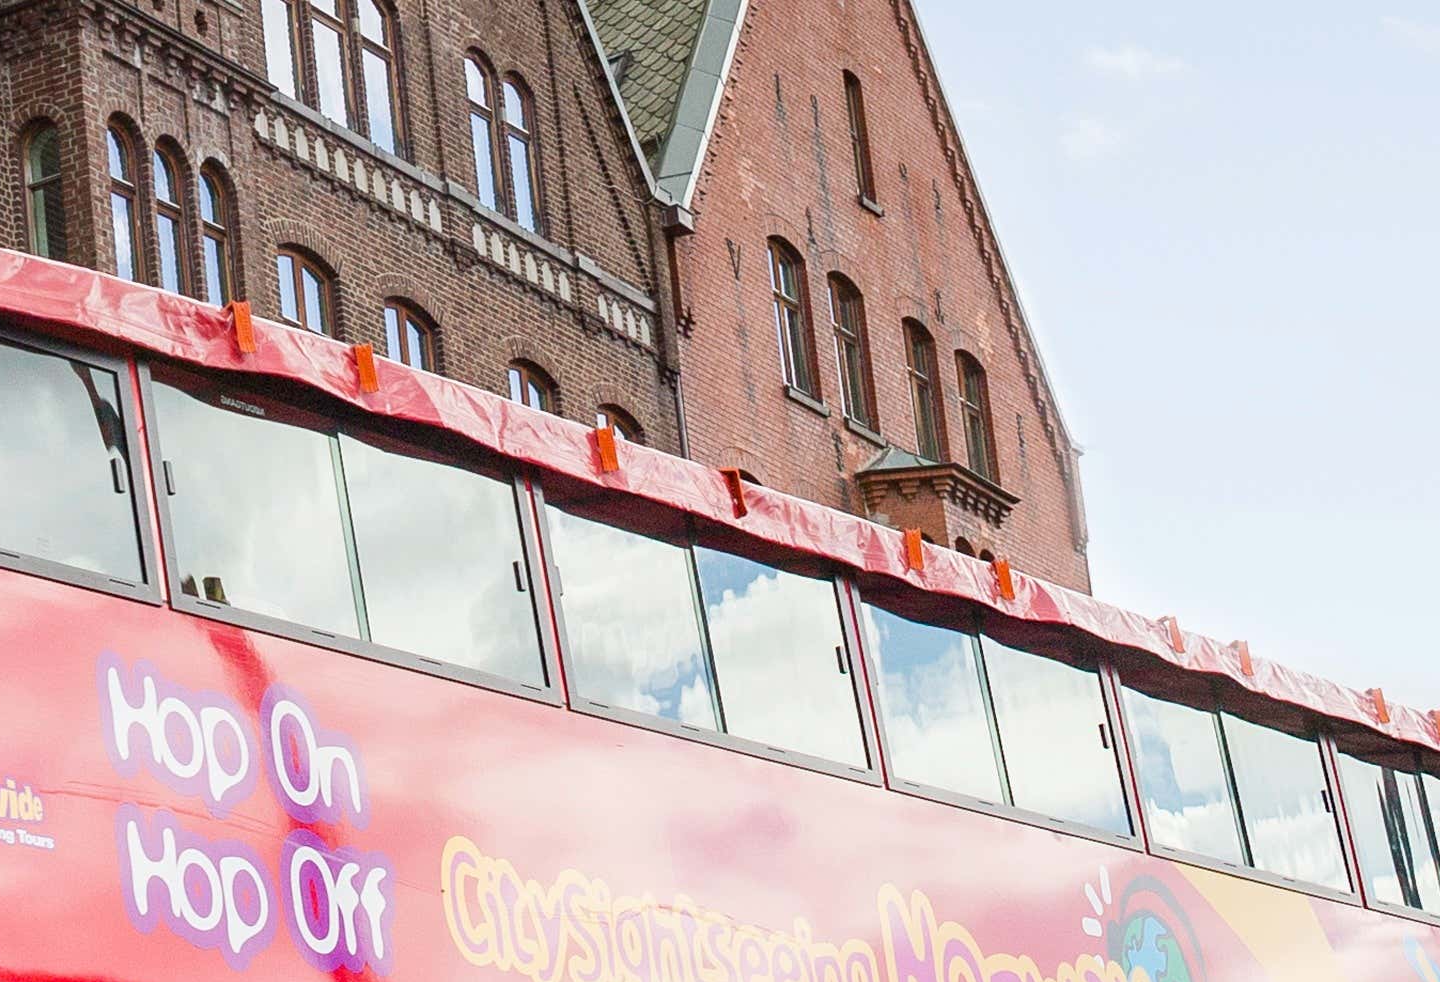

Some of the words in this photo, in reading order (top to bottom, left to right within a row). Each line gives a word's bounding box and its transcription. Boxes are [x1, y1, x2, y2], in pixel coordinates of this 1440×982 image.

[108, 666, 249, 801] Hop
[270, 700, 361, 813] On
[16, 828, 55, 849] Tours
[127, 820, 268, 954] Hop
[290, 846, 387, 960] Off
